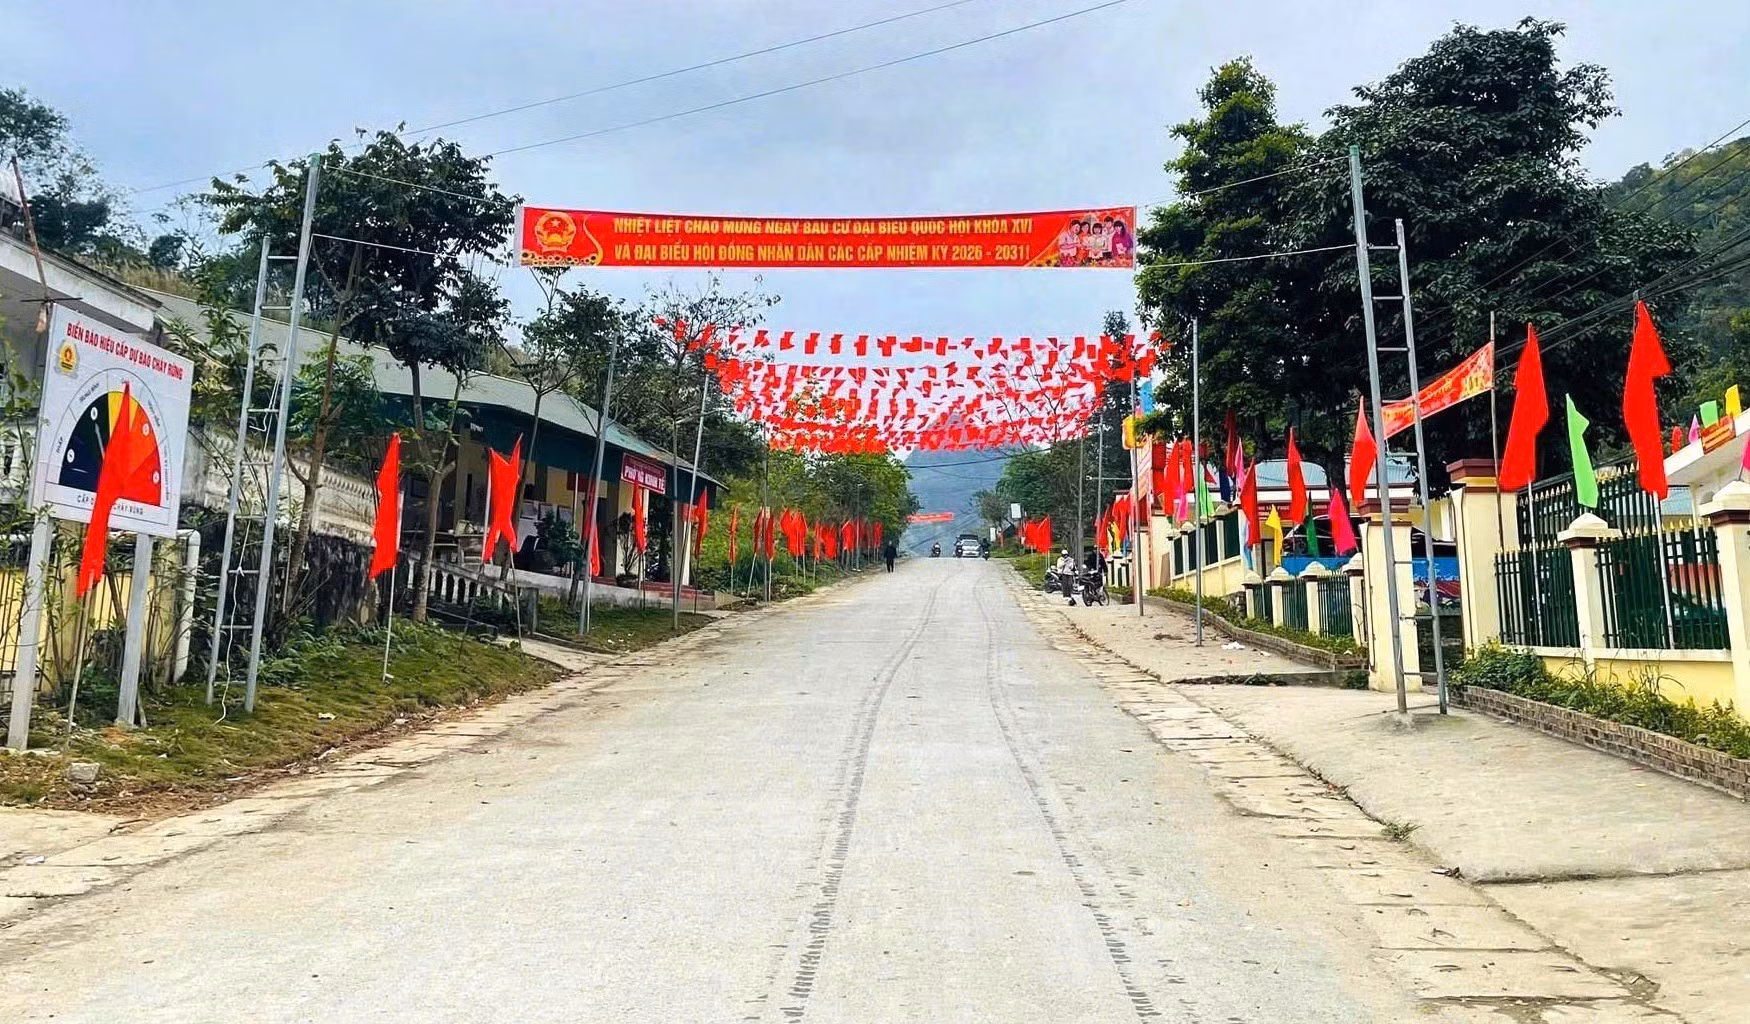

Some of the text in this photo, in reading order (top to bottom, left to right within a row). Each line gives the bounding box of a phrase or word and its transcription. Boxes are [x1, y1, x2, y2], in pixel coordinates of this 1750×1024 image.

[1011, 217, 1033, 234] XVI
[614, 242, 631, 261] VÀ
[634, 244, 656, 264] ĐẠI
[693, 241, 715, 264] HỘI
[757, 242, 794, 261] NHÂN
[797, 242, 824, 261] DÂN
[828, 242, 853, 261] CÁC
[857, 240, 883, 261] CẤP
[886, 243, 928, 265] NHIỆM
[952, 244, 983, 261] 2026
